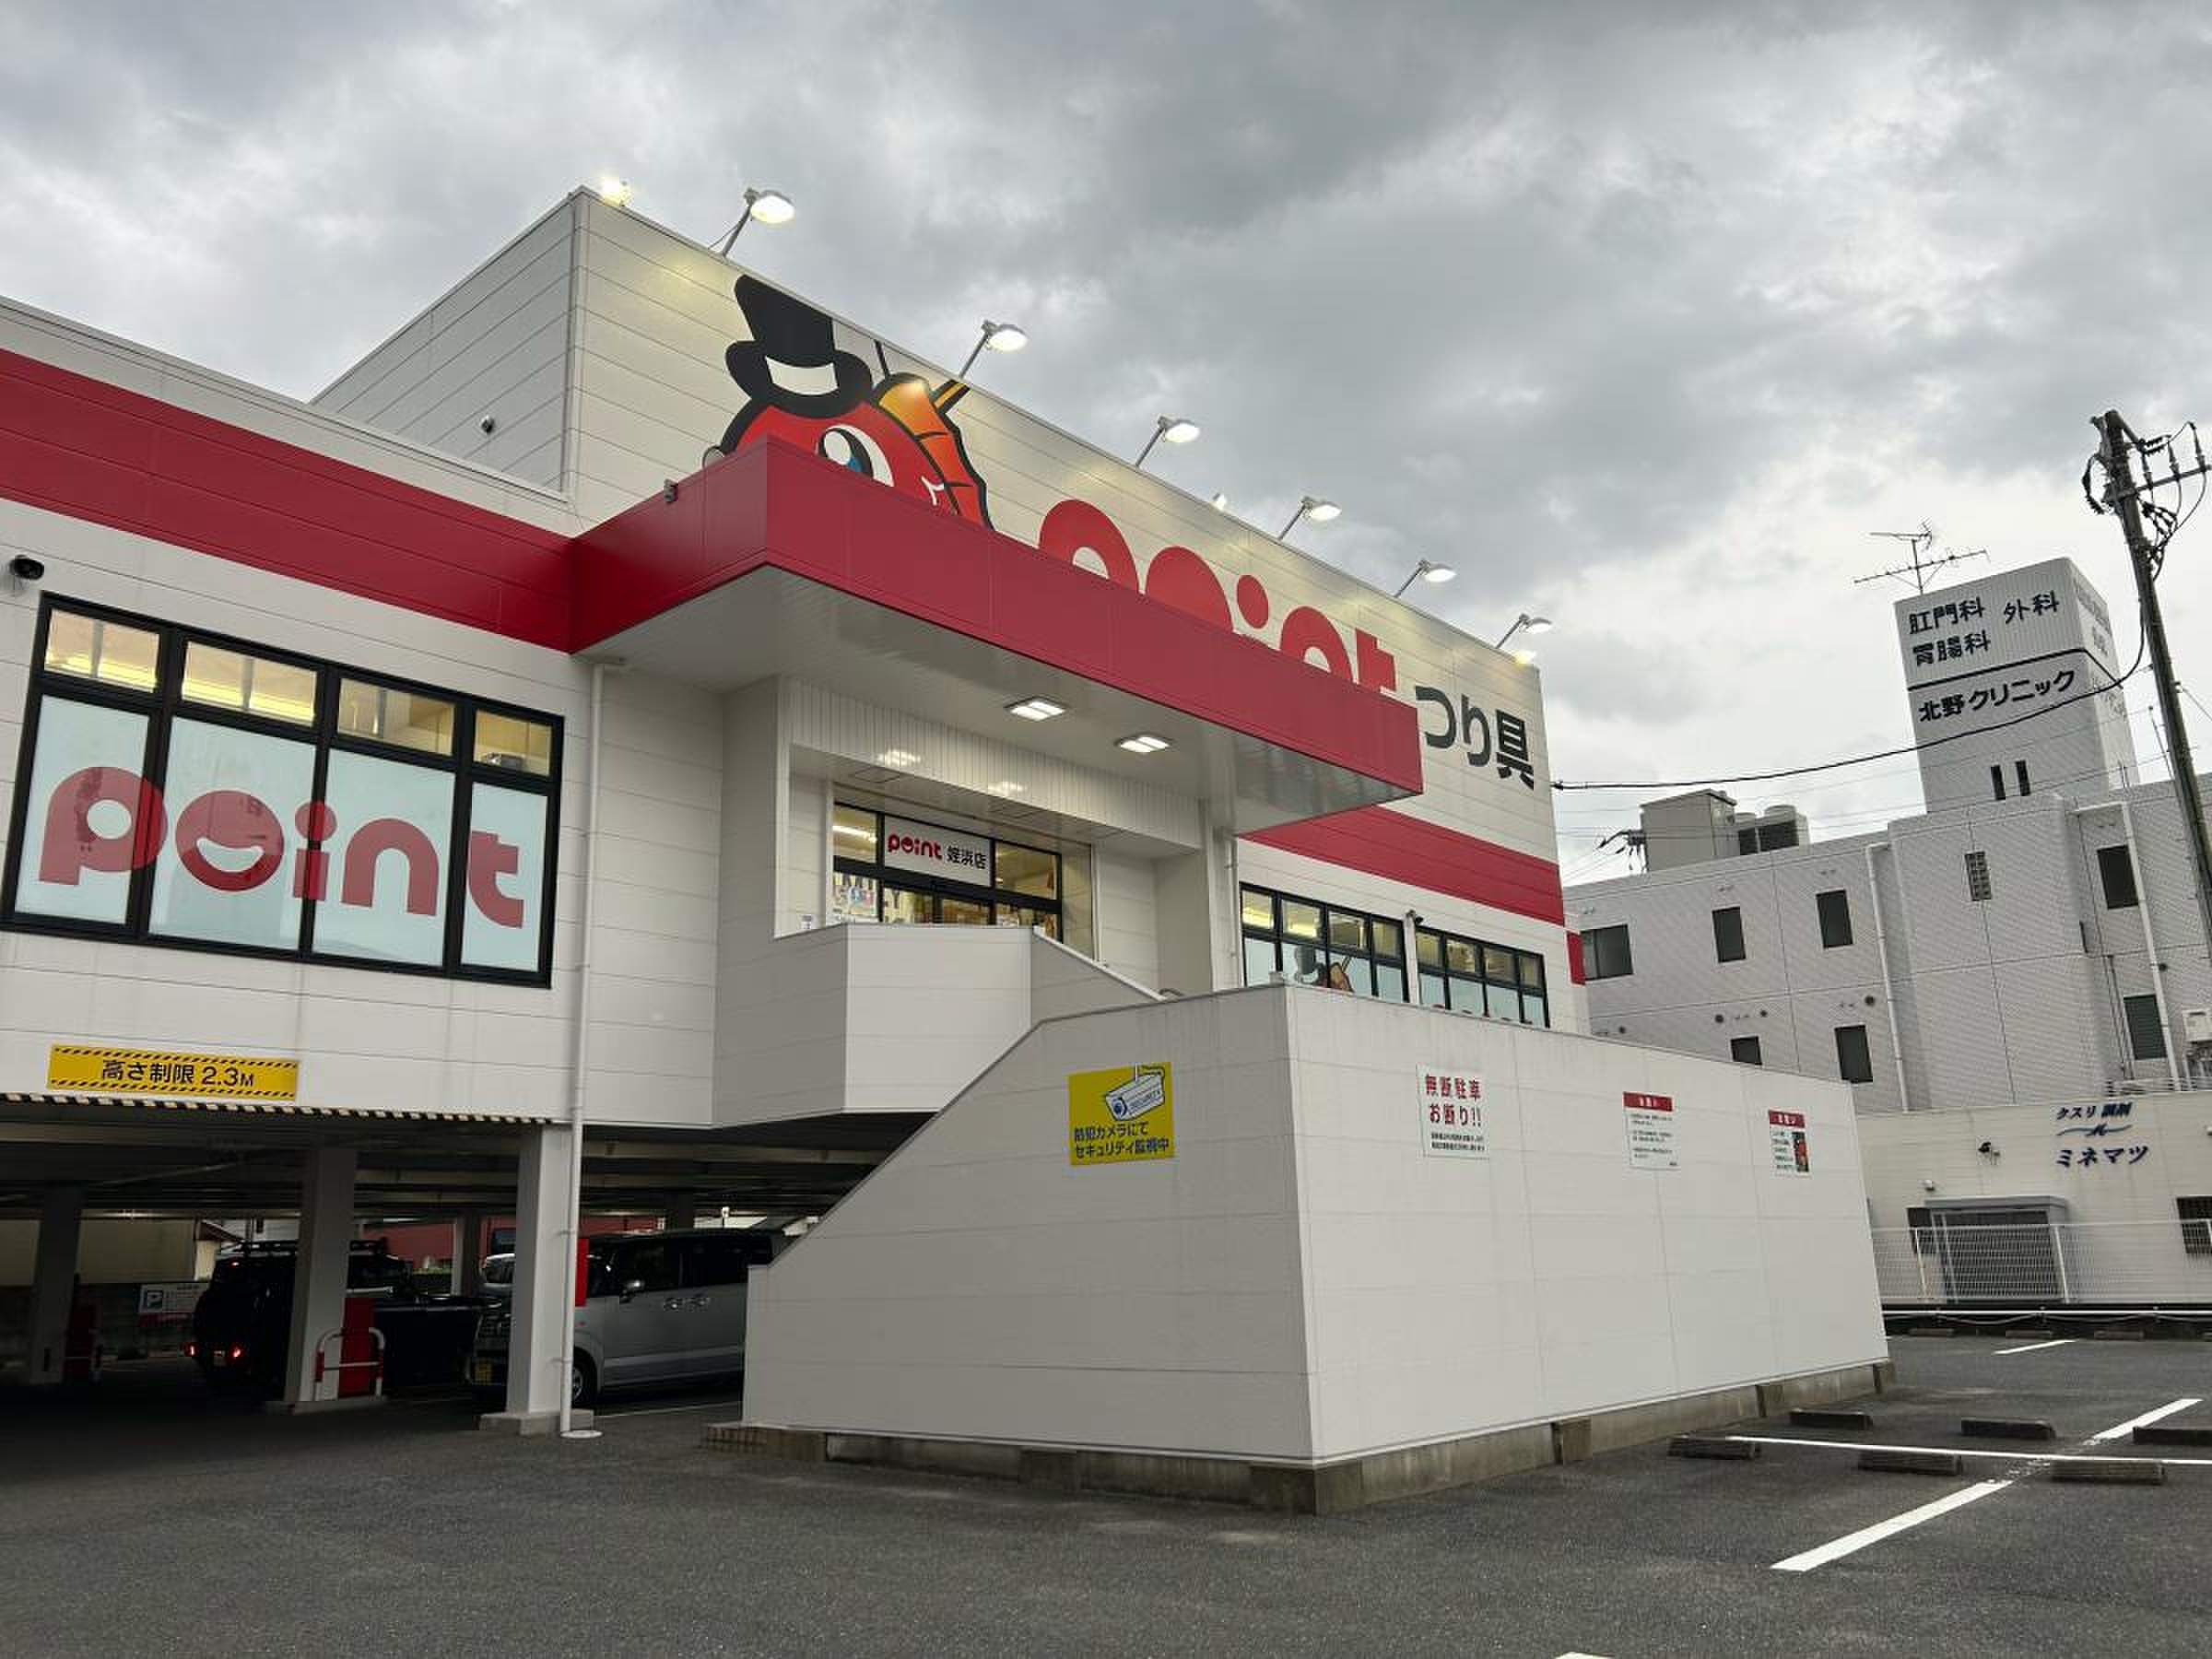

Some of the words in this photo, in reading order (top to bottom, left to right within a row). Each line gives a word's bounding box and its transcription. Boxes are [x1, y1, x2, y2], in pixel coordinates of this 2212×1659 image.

[1909, 597, 1985, 635] 肛門科
[2003, 591, 2060, 624] 外科
[1912, 630, 1991, 666] 胃腸科
[1918, 670, 2075, 723] 北野クリニック
[1415, 686, 1535, 790] つり具
[39, 766, 524, 929] point
[888, 834, 943, 860] point
[101, 1059, 194, 1085] 高さ制限
[2056, 1105, 2096, 1120] クスリ
[2056, 1146, 2149, 1168] ミネマツ
